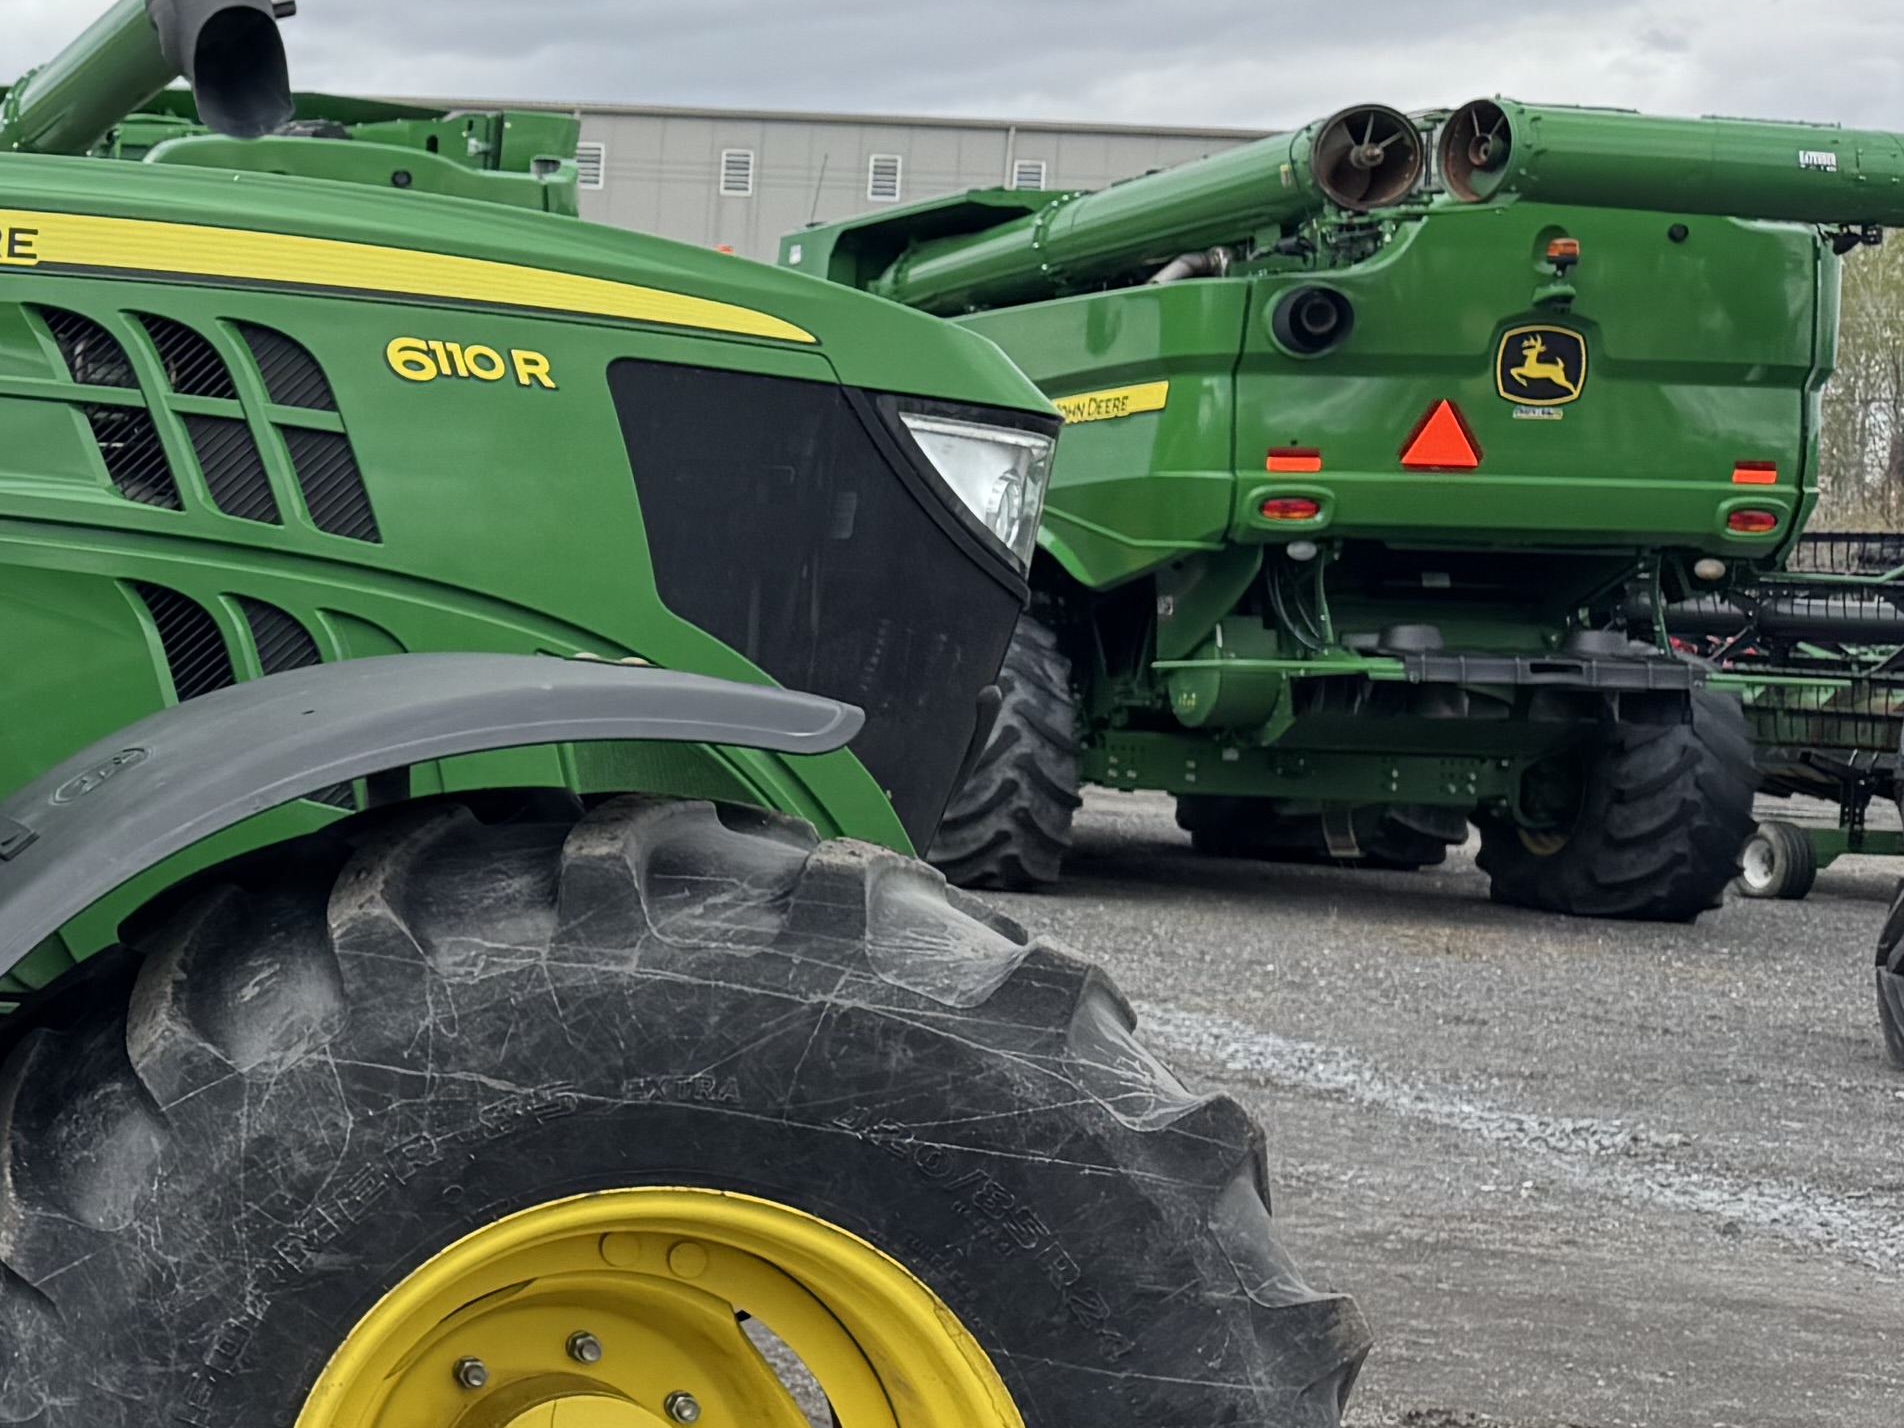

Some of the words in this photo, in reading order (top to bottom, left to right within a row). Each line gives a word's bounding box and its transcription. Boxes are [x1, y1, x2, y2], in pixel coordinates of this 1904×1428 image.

[386, 336, 506, 383] 6110
[510, 349, 558, 389] R
[1088, 396, 1129, 416] DEERE
[624, 1075, 742, 1105] EXTRA
